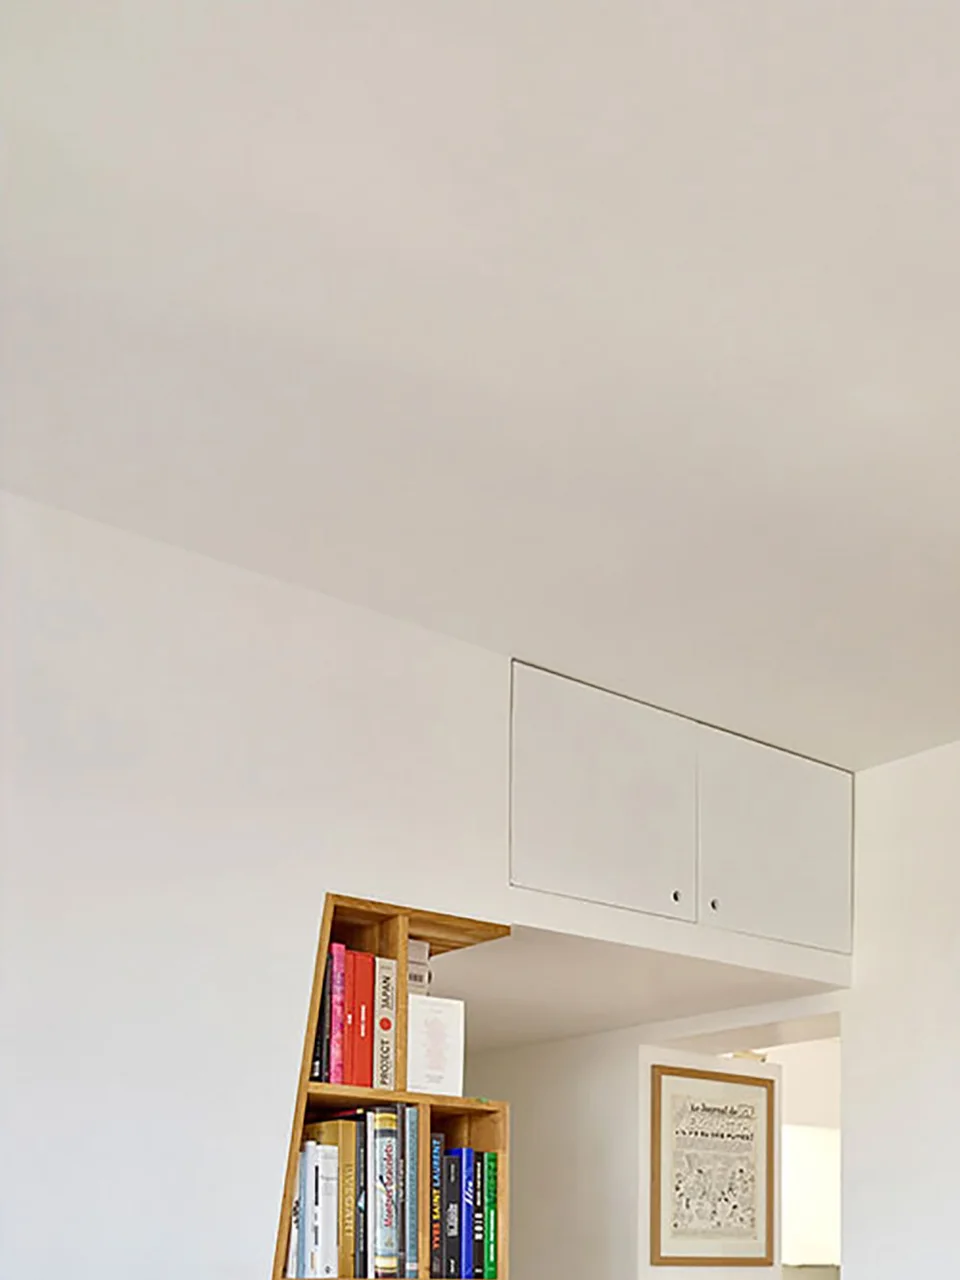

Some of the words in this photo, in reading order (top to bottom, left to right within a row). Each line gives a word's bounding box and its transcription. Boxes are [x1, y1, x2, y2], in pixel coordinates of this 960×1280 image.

[381, 975, 393, 1009] JAPAN
[379, 1039, 392, 1085] PROJECT
[432, 1140, 441, 1188] LAURENT
[432, 1190, 441, 1221] SAINT
[432, 1225, 441, 1250] YVES
